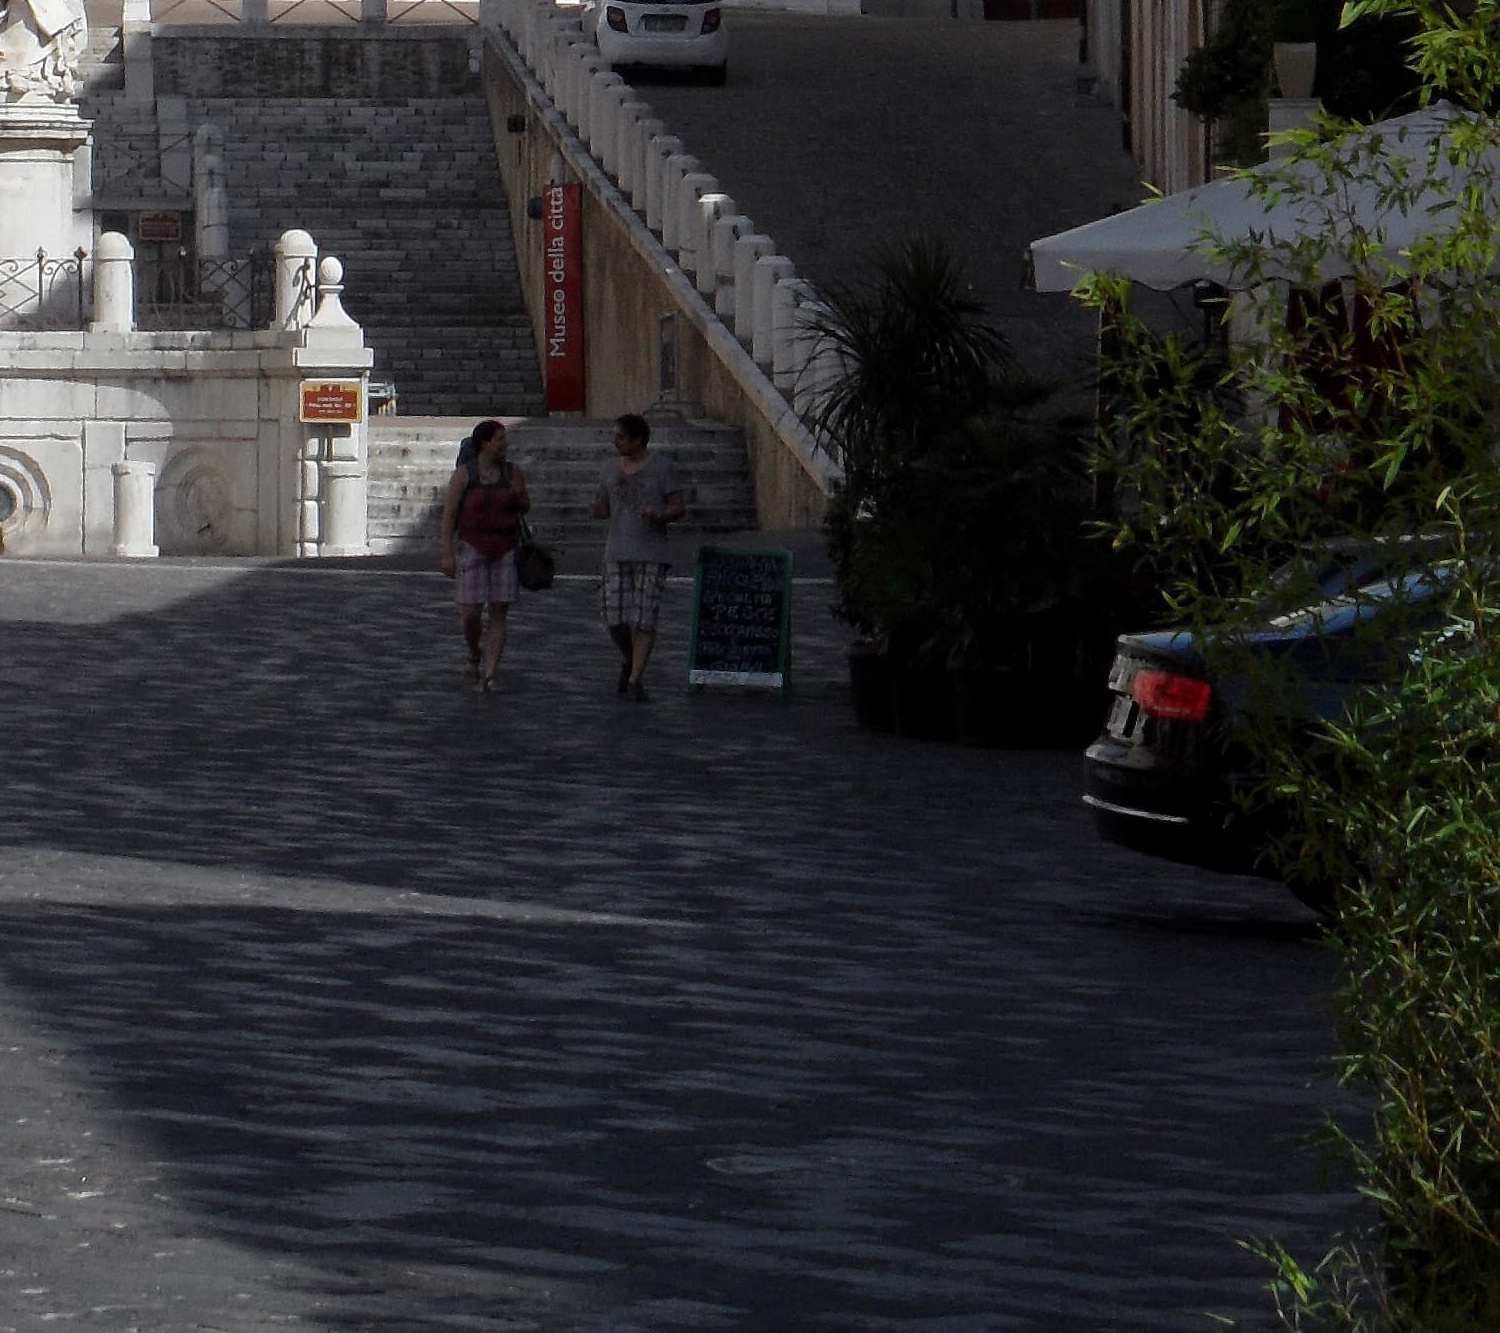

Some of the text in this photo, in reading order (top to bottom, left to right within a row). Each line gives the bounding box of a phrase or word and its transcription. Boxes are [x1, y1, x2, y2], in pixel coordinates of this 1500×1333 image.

[546, 186, 566, 357] Museo della città
